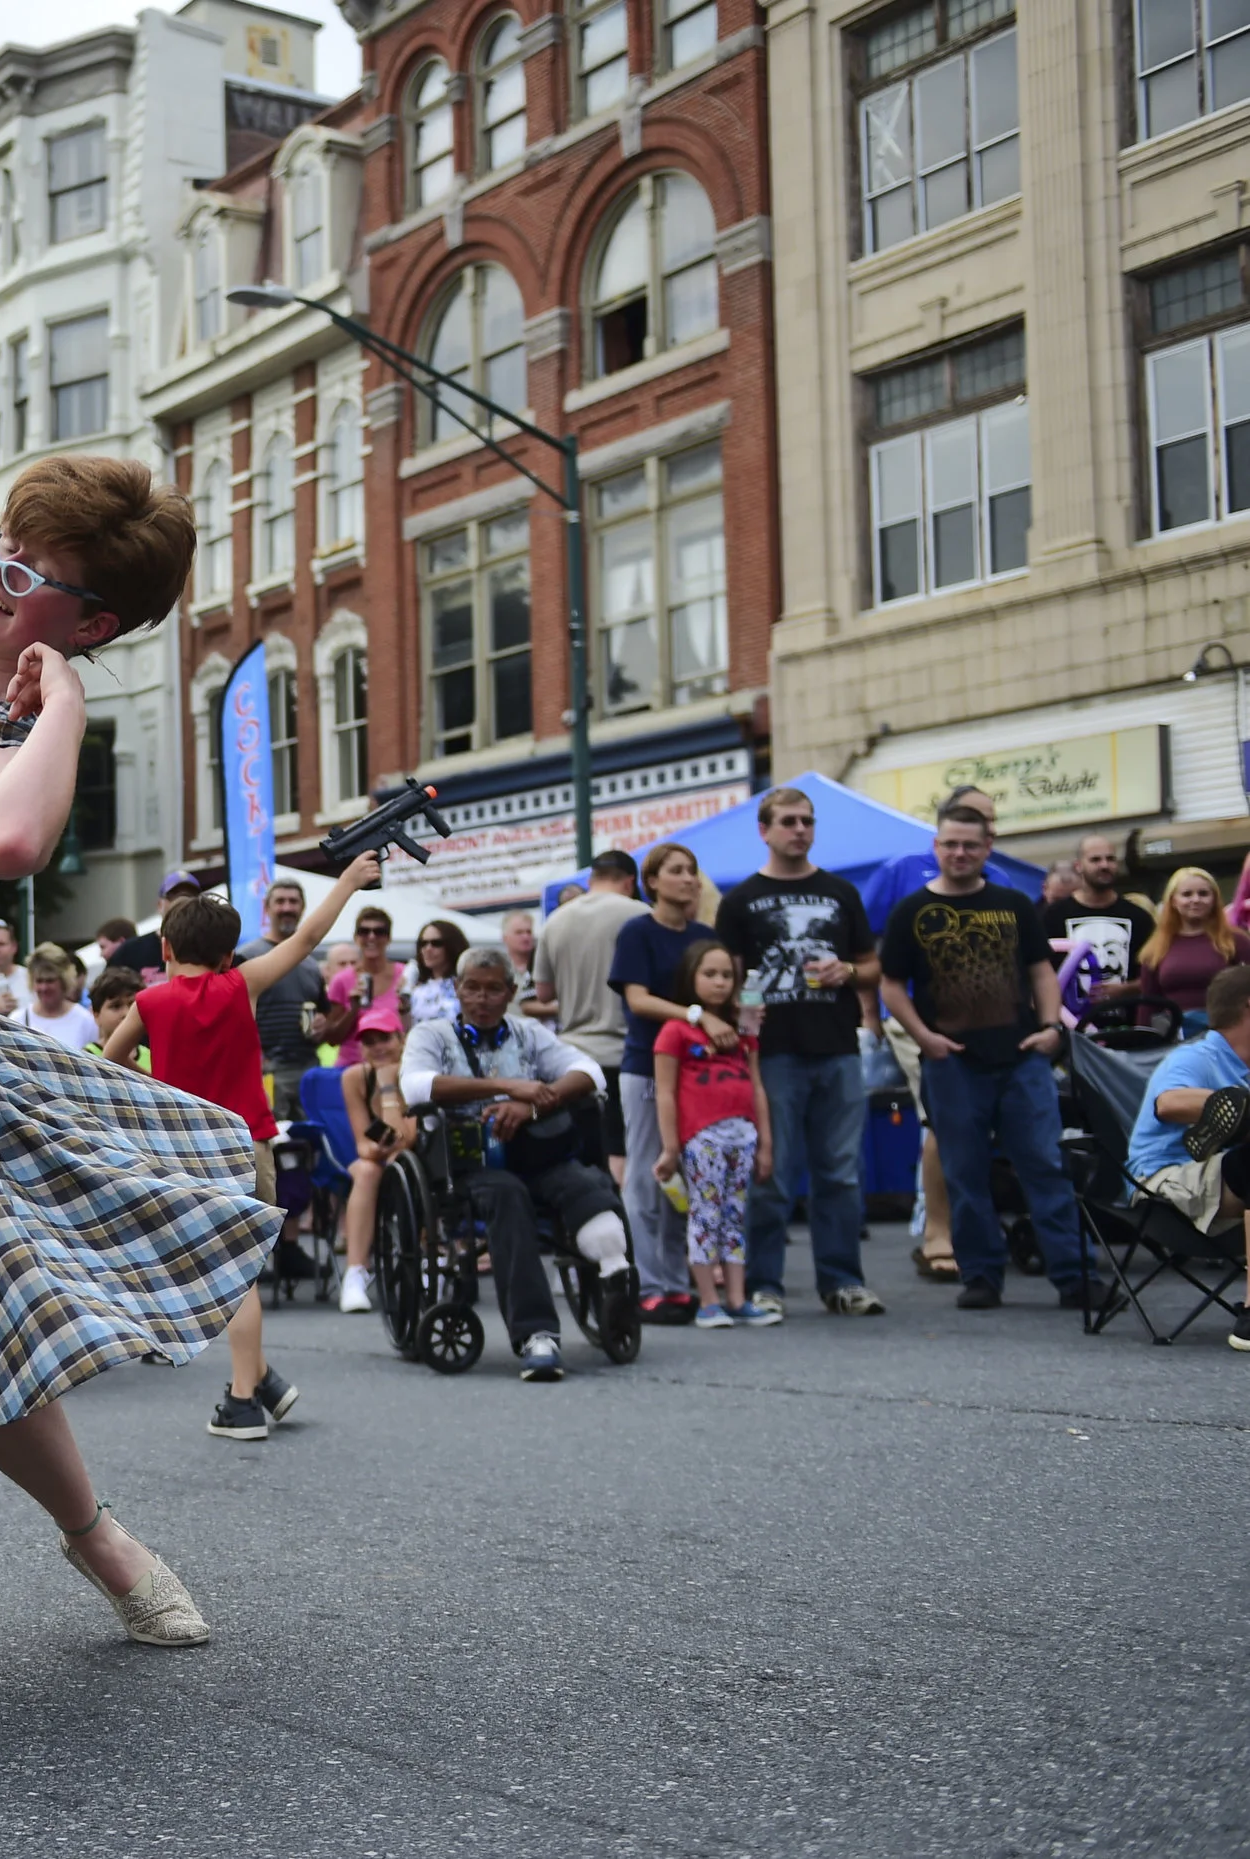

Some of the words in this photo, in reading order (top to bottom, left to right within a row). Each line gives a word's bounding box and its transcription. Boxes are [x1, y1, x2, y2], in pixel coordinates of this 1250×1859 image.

[638, 796, 721, 827] CIGARETTE
[748, 897, 776, 912] THE
[779, 895, 840, 908] BEATLES
[974, 910, 1018, 925] NIRVANA
